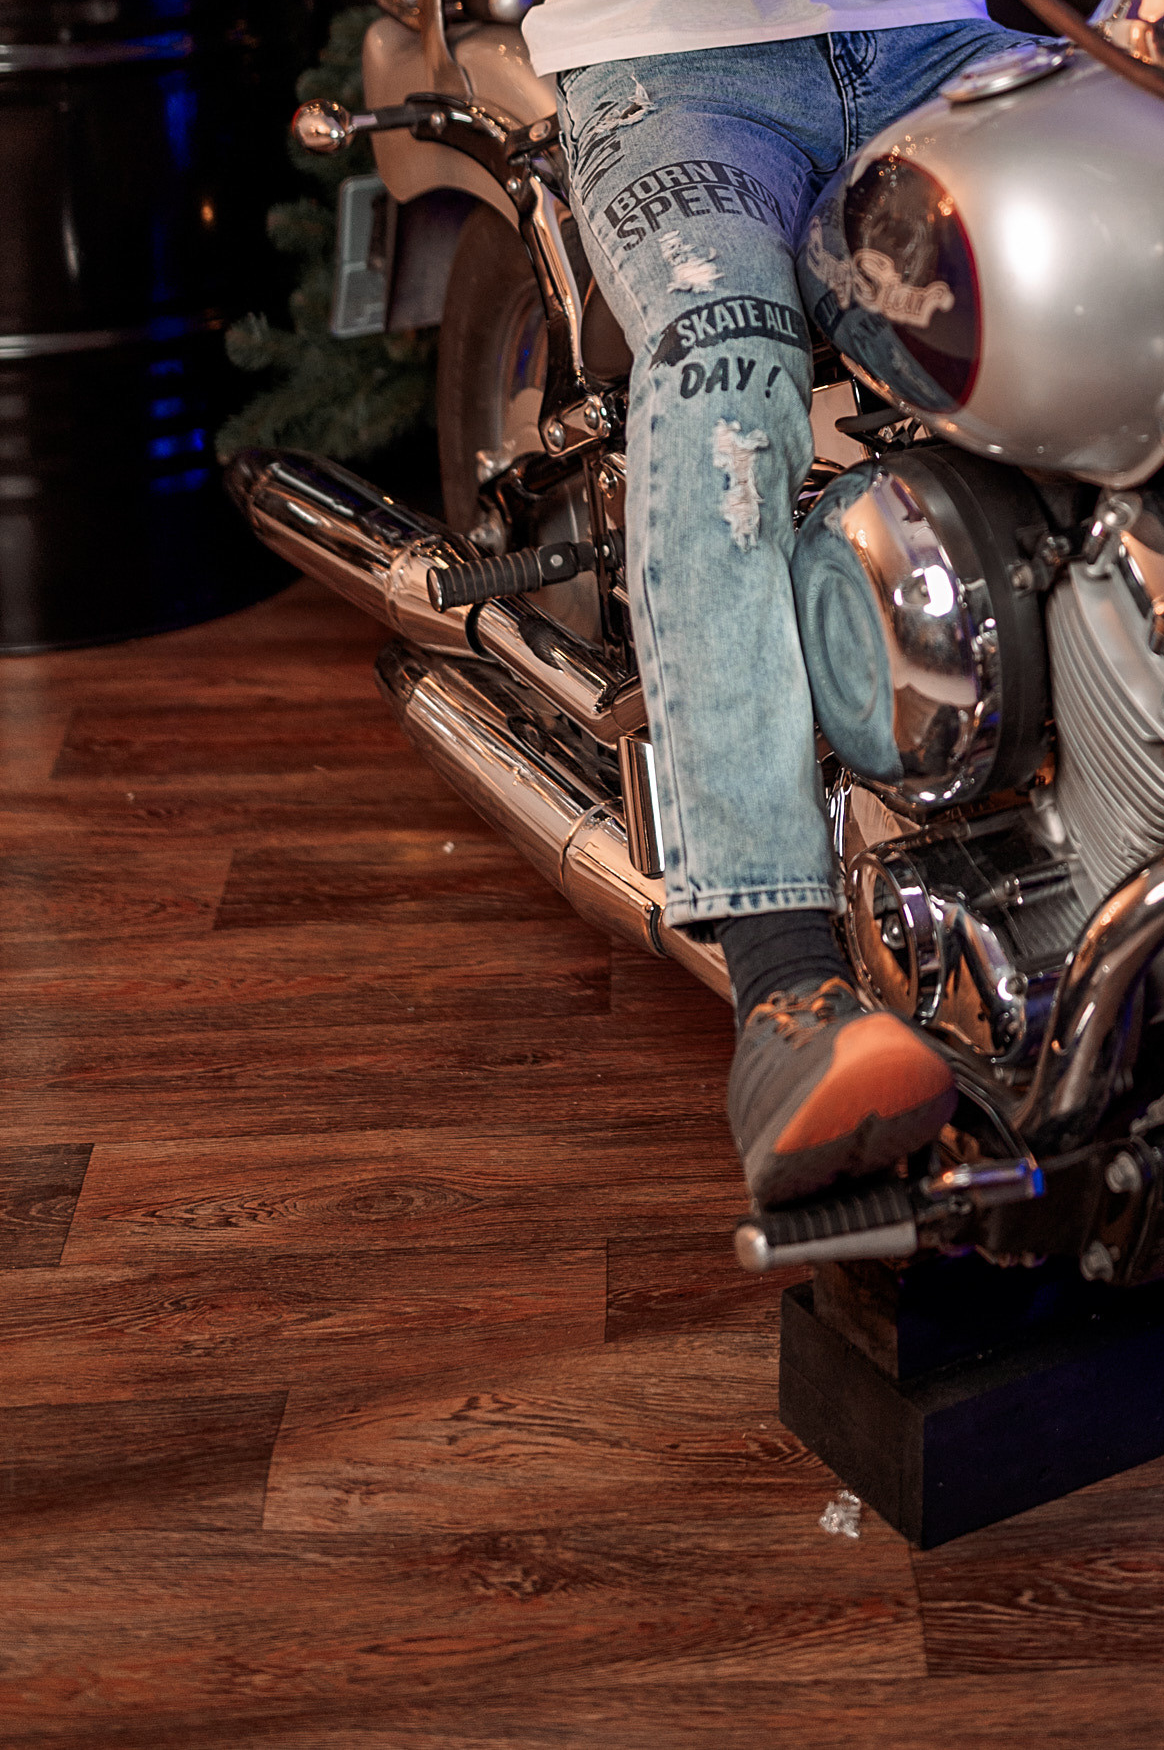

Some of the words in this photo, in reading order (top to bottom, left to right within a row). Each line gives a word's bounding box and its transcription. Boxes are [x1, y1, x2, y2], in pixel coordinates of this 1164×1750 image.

[609, 162, 719, 221] BORN
[616, 184, 769, 251] SPEED
[676, 299, 762, 347] SKATE
[763, 303, 799, 339] ALL
